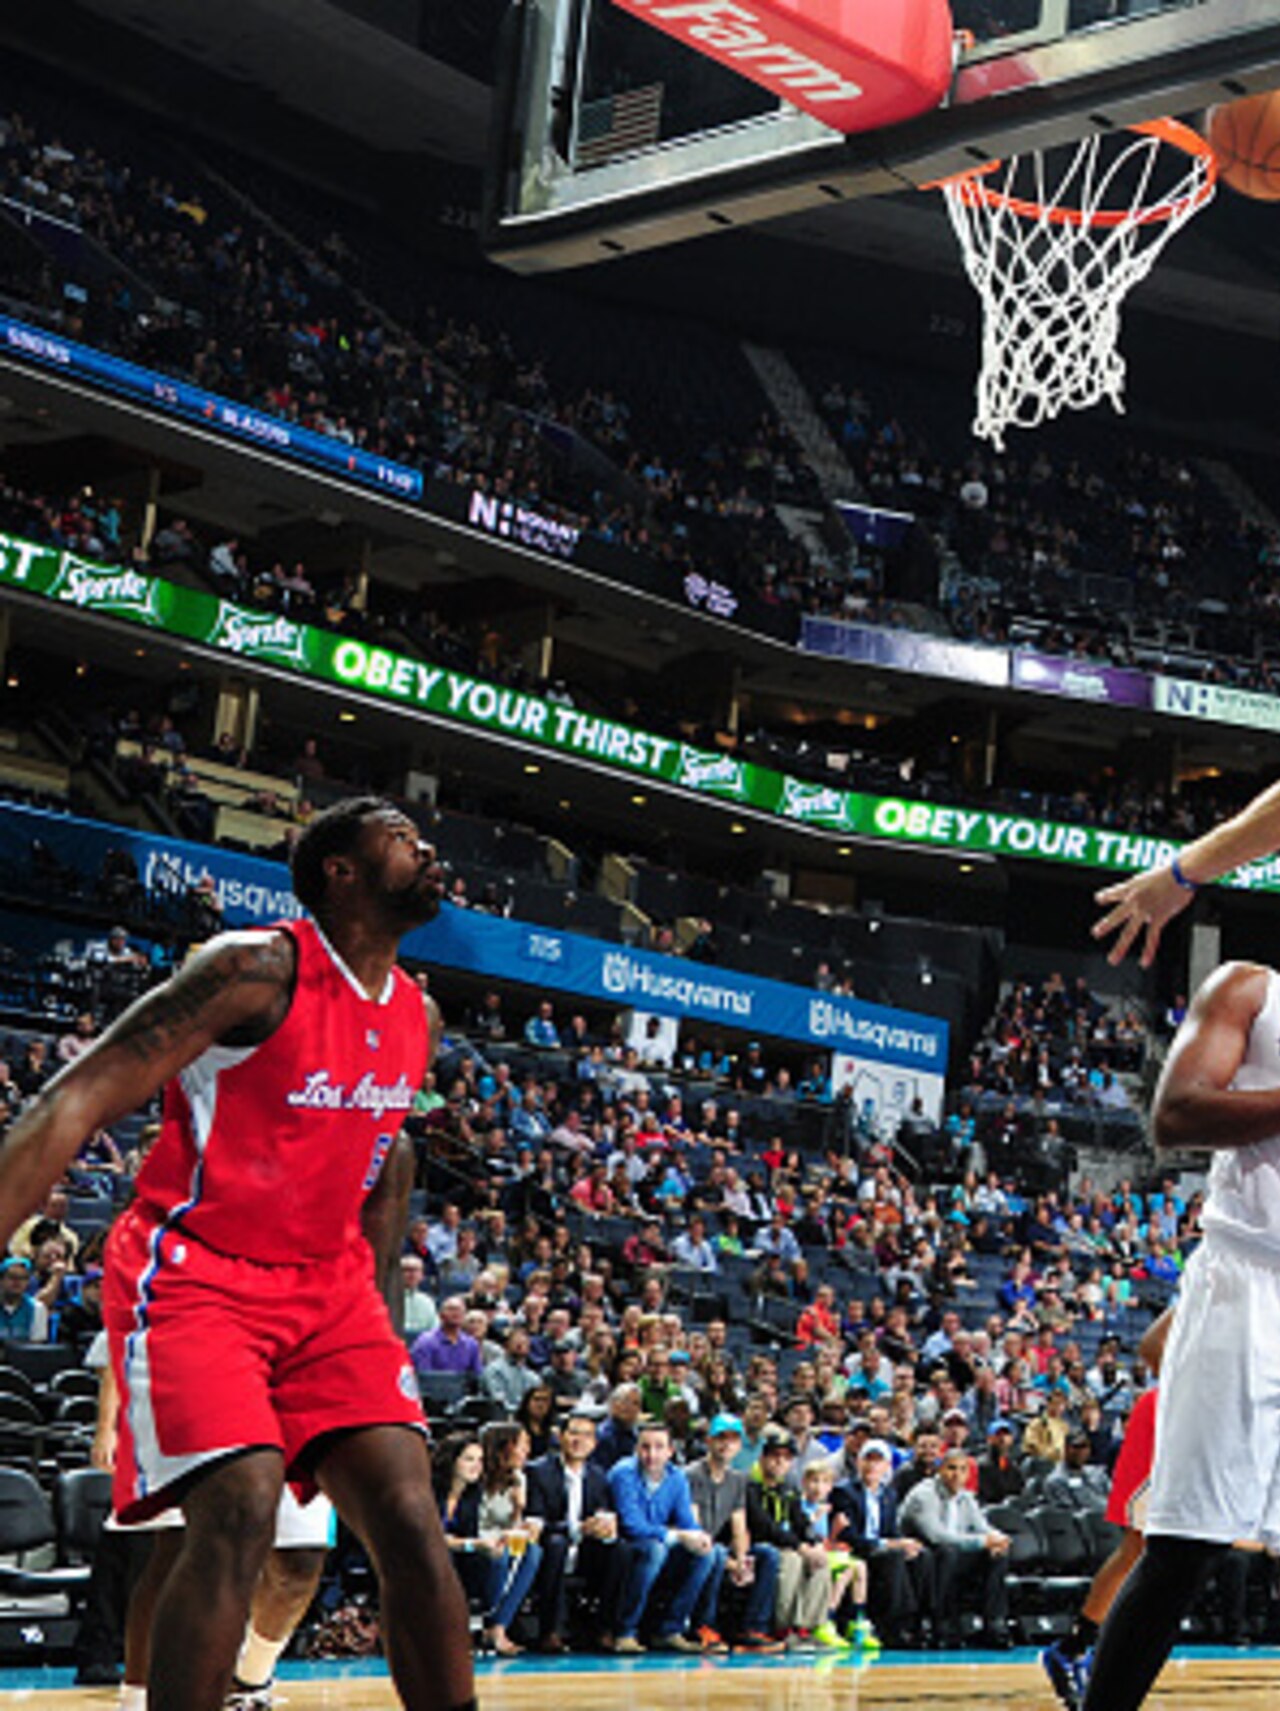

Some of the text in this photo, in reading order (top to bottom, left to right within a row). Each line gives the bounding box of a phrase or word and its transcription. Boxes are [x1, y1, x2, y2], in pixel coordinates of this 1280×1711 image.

[650, 0, 863, 103] Farm
[468, 491, 498, 531] N
[60, 568, 149, 606] Sprite
[219, 614, 299, 652] Sprite
[333, 640, 444, 701] OBEY
[447, 674, 549, 737] YOUR
[554, 707, 673, 772] THIRST
[874, 799, 984, 842] OBEY
[985, 813, 1089, 859] YOUR
[1095, 831, 1190, 872] THIR
[631, 962, 753, 1017] Husqvarna
[831, 1008, 938, 1058] Husqvarna
[286, 1069, 414, 1121] Los Angele
